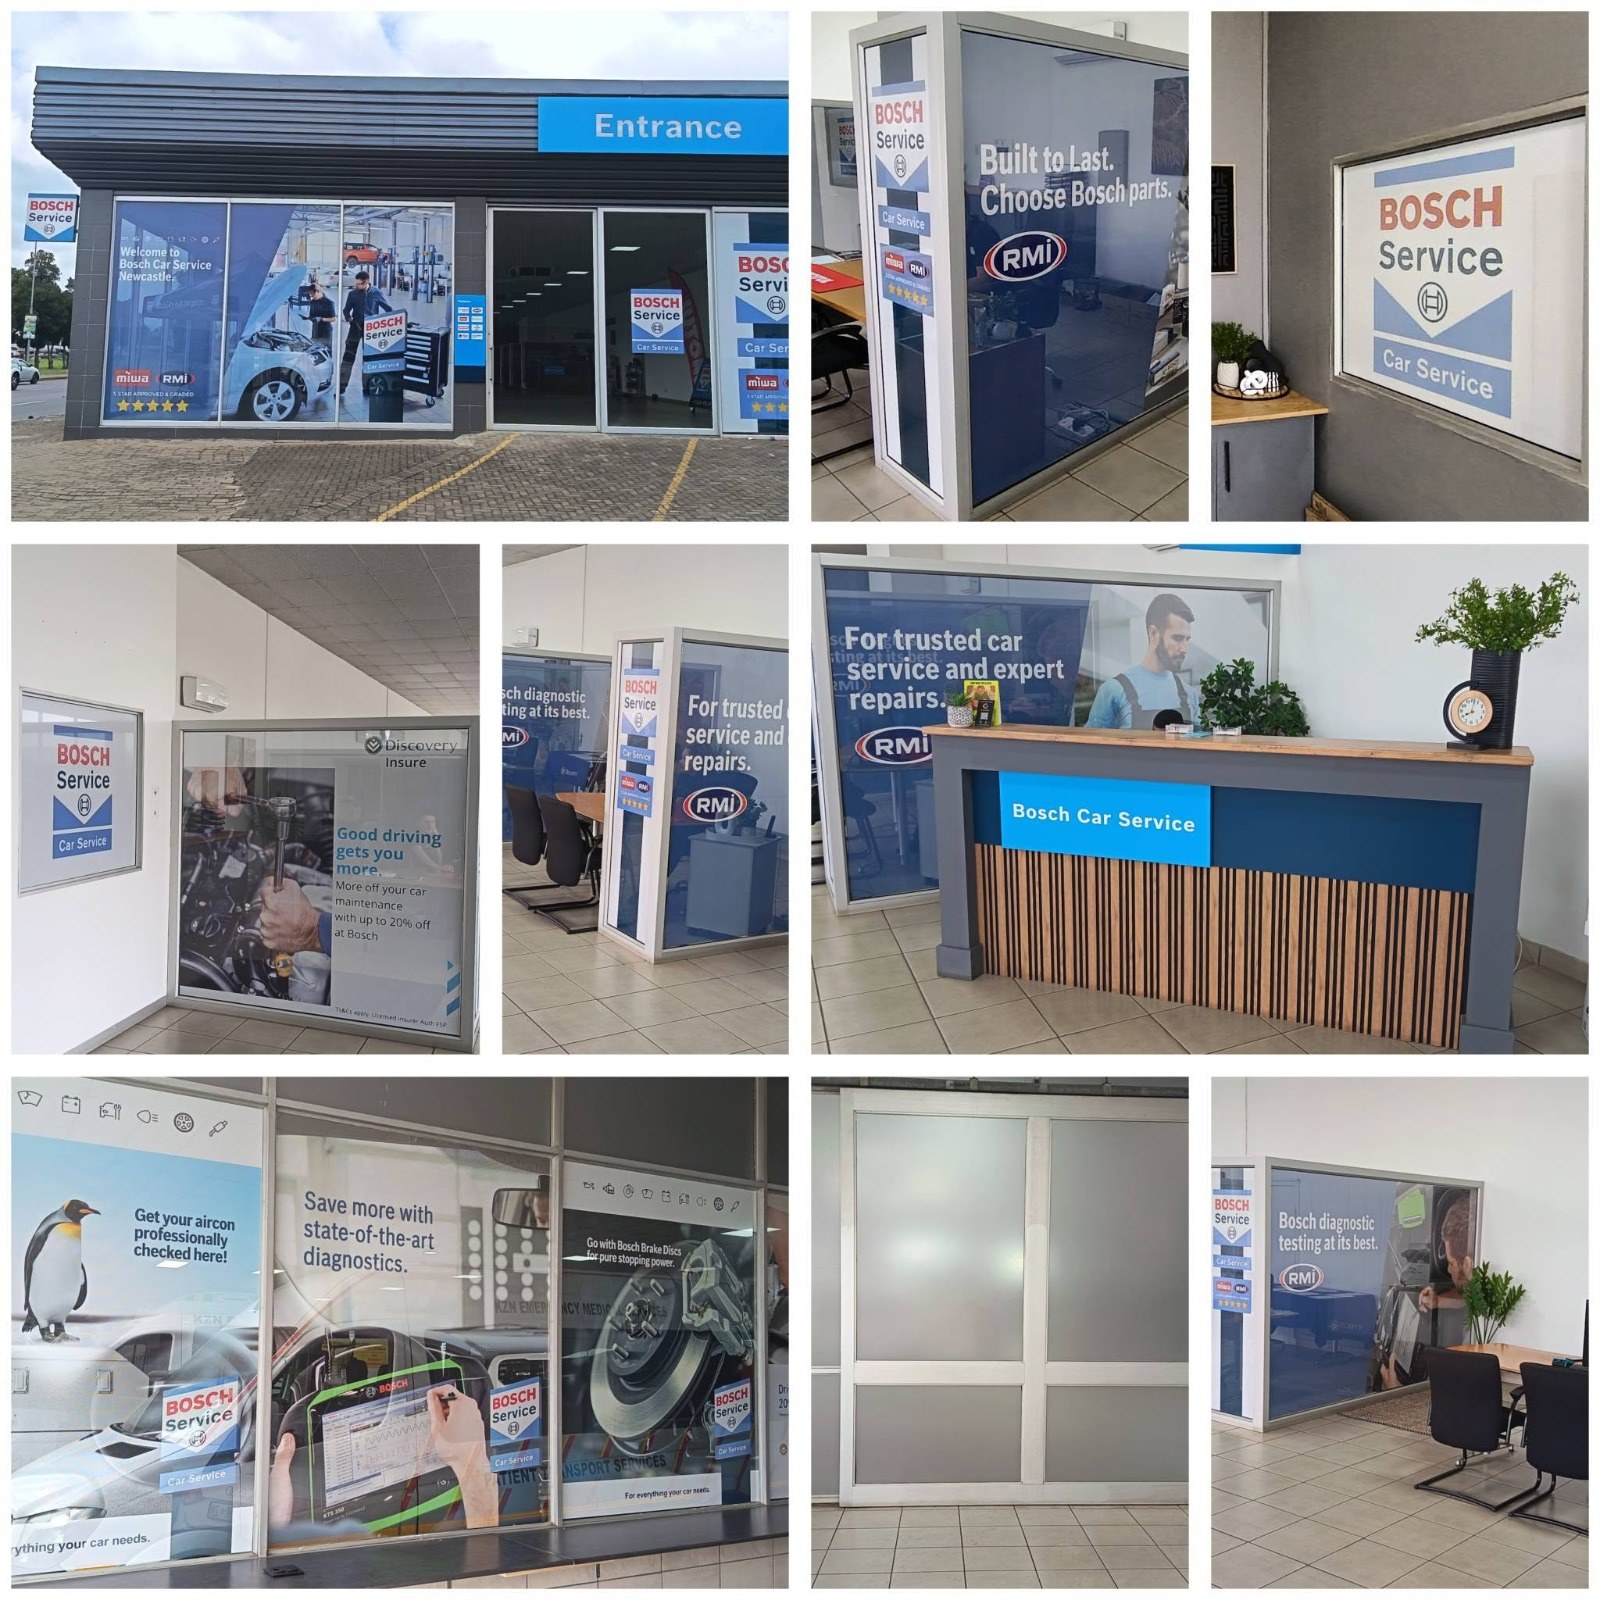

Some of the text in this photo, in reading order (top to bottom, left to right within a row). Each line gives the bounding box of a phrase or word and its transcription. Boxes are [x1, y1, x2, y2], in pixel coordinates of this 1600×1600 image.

[875, 100, 923, 125] BOSCH
[595, 113, 742, 139] Entrance
[876, 128, 924, 149] Service
[980, 142, 1114, 176] Built to Last.
[980, 176, 1172, 216] Choose Bosch parts.
[30, 201, 74, 211] BOSCH
[1379, 185, 1503, 231] BOSCH
[29, 212, 72, 223] Service
[883, 211, 925, 230] Car Service
[121, 247, 180, 257] Welcome to
[1378, 238, 1504, 277] Service
[119, 259, 212, 270] Bosch Car Service
[119, 271, 175, 282] Newcastle.
[634, 297, 680, 308] BOSCH
[366, 316, 403, 331] BOSCH
[634, 310, 680, 320] Service
[366, 328, 403, 340] Service
[745, 343, 765, 353] Car
[116, 371, 149, 383] miwa
[748, 376, 777, 387] miwa
[1383, 348, 1494, 400] Car Service
[845, 626, 1023, 652] For trusted car
[847, 656, 1064, 684] service and expert
[524, 687, 586, 704] diagnostic
[626, 680, 657, 695] BOSCH
[624, 697, 656, 711] Service
[688, 694, 784, 719] For trusted
[850, 686, 947, 714] repairs.
[530, 705, 541, 717] at
[544, 704, 559, 718] its
[562, 706, 590, 719] best.
[686, 723, 785, 745] service and
[57, 743, 110, 766] BOSCH
[386, 739, 458, 753] Discovery
[386, 757, 427, 768] Insure
[684, 750, 751, 776] repairs.
[56, 770, 110, 790] Service
[1013, 803, 1196, 832] Bosch Car Service
[59, 835, 107, 852] Car Service
[337, 827, 442, 849] Good driving
[336, 846, 404, 863] gets you
[336, 864, 382, 877] more.
[335, 881, 427, 896] More off your car
[335, 897, 403, 911] maintenance
[334, 913, 431, 930] with up to 20% off
[334, 929, 379, 942] at Bosch
[304, 1191, 433, 1225] Save more with
[1215, 1199, 1250, 1211] BOSCH
[135, 1208, 235, 1232] Get your aircon
[1214, 1213, 1250, 1225] Service
[1279, 1212, 1375, 1234] Bosch diagnostic
[134, 1227, 228, 1249] professionally
[304, 1220, 435, 1250] state-of-the-art
[134, 1243, 228, 1263] checked here!
[587, 1237, 682, 1257] Go with Bosch Brake Discs
[1279, 1235, 1378, 1254] testing at its best.
[304, 1247, 408, 1273] diagnostics.
[587, 1250, 675, 1268] for pure stopping power.
[379, 1379, 408, 1393] BOSCH
[166, 1388, 234, 1416] BOSCH
[492, 1387, 537, 1410] BOSCH
[716, 1387, 748, 1407] BOSCH
[492, 1404, 537, 1424] Service
[716, 1402, 749, 1419] Service
[165, 1409, 234, 1432] Service
[718, 1444, 747, 1455] Car Service
[495, 1454, 534, 1467] Car Service
[168, 1470, 227, 1488] Car Service
[625, 1492, 635, 1500] For
[636, 1489, 668, 1500] everything
[669, 1488, 682, 1498] your
[683, 1487, 692, 1495] car
[58, 1540, 88, 1553] your
[90, 1538, 110, 1549] car
[112, 1533, 151, 1546] needs.
